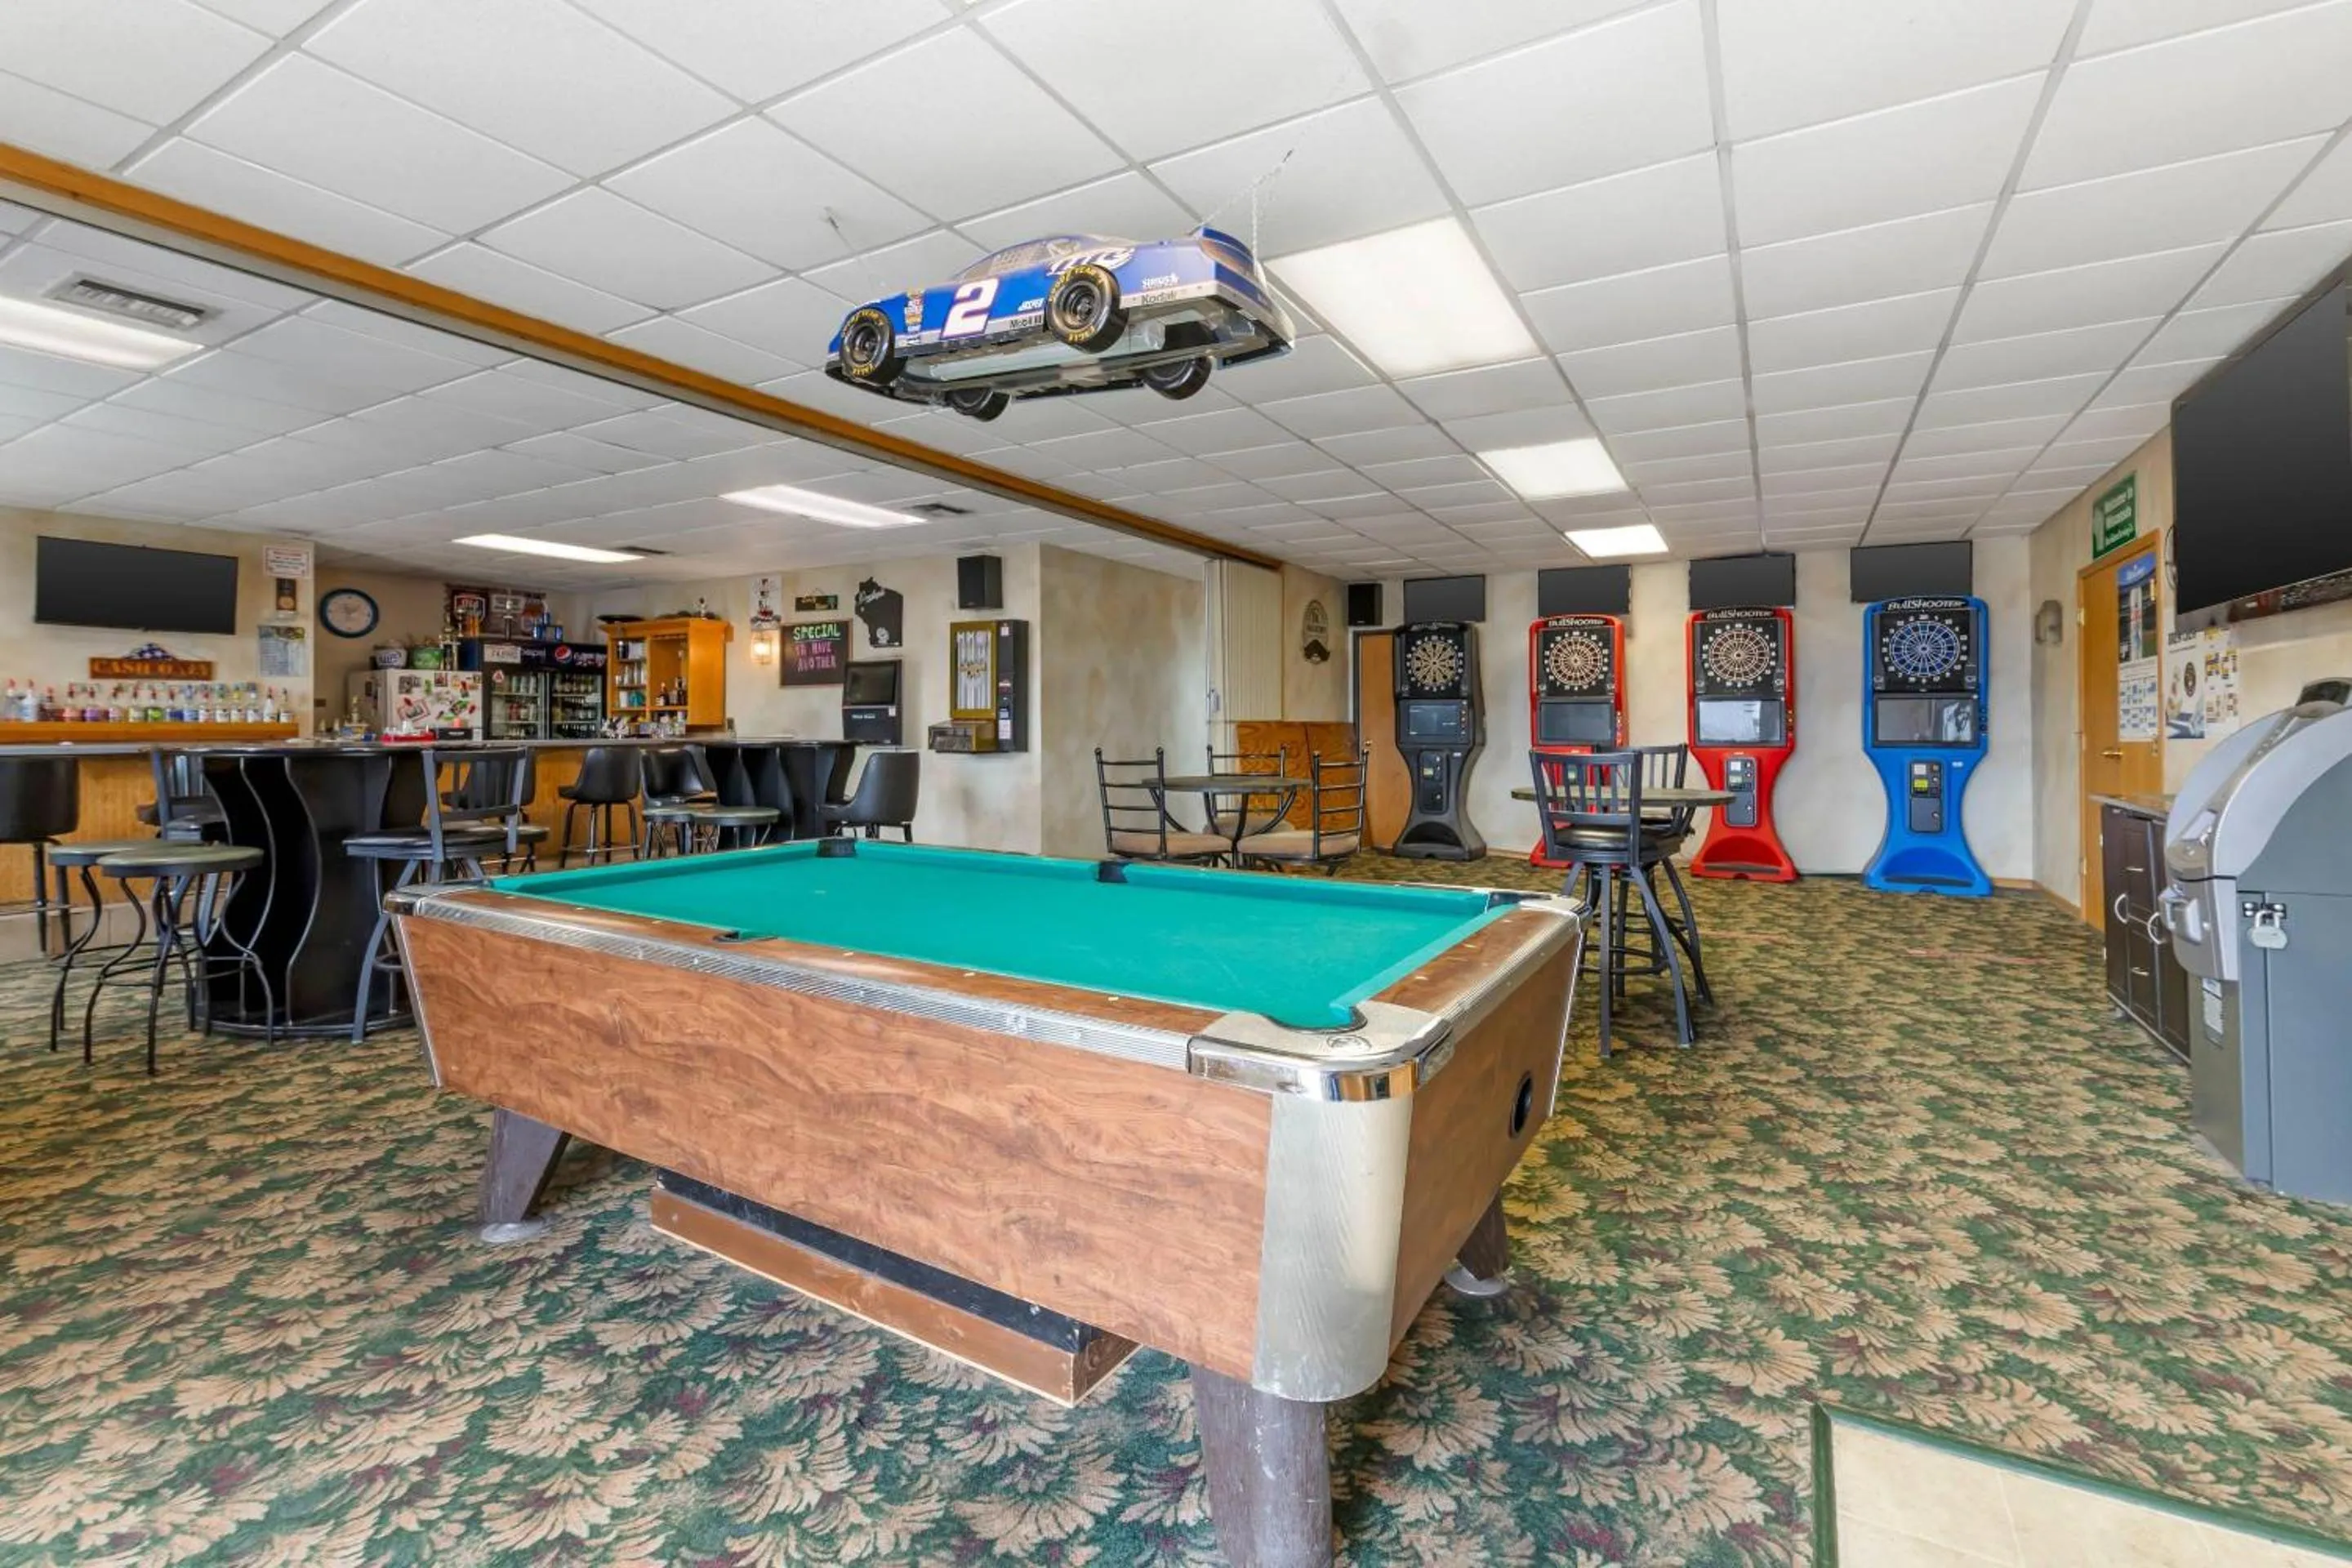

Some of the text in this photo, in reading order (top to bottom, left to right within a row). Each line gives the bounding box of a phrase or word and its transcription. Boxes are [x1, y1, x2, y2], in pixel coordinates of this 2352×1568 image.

[941, 277, 1000, 339] 2
[793, 623, 841, 641] SPECIAL
[93, 659, 151, 675] CASH
